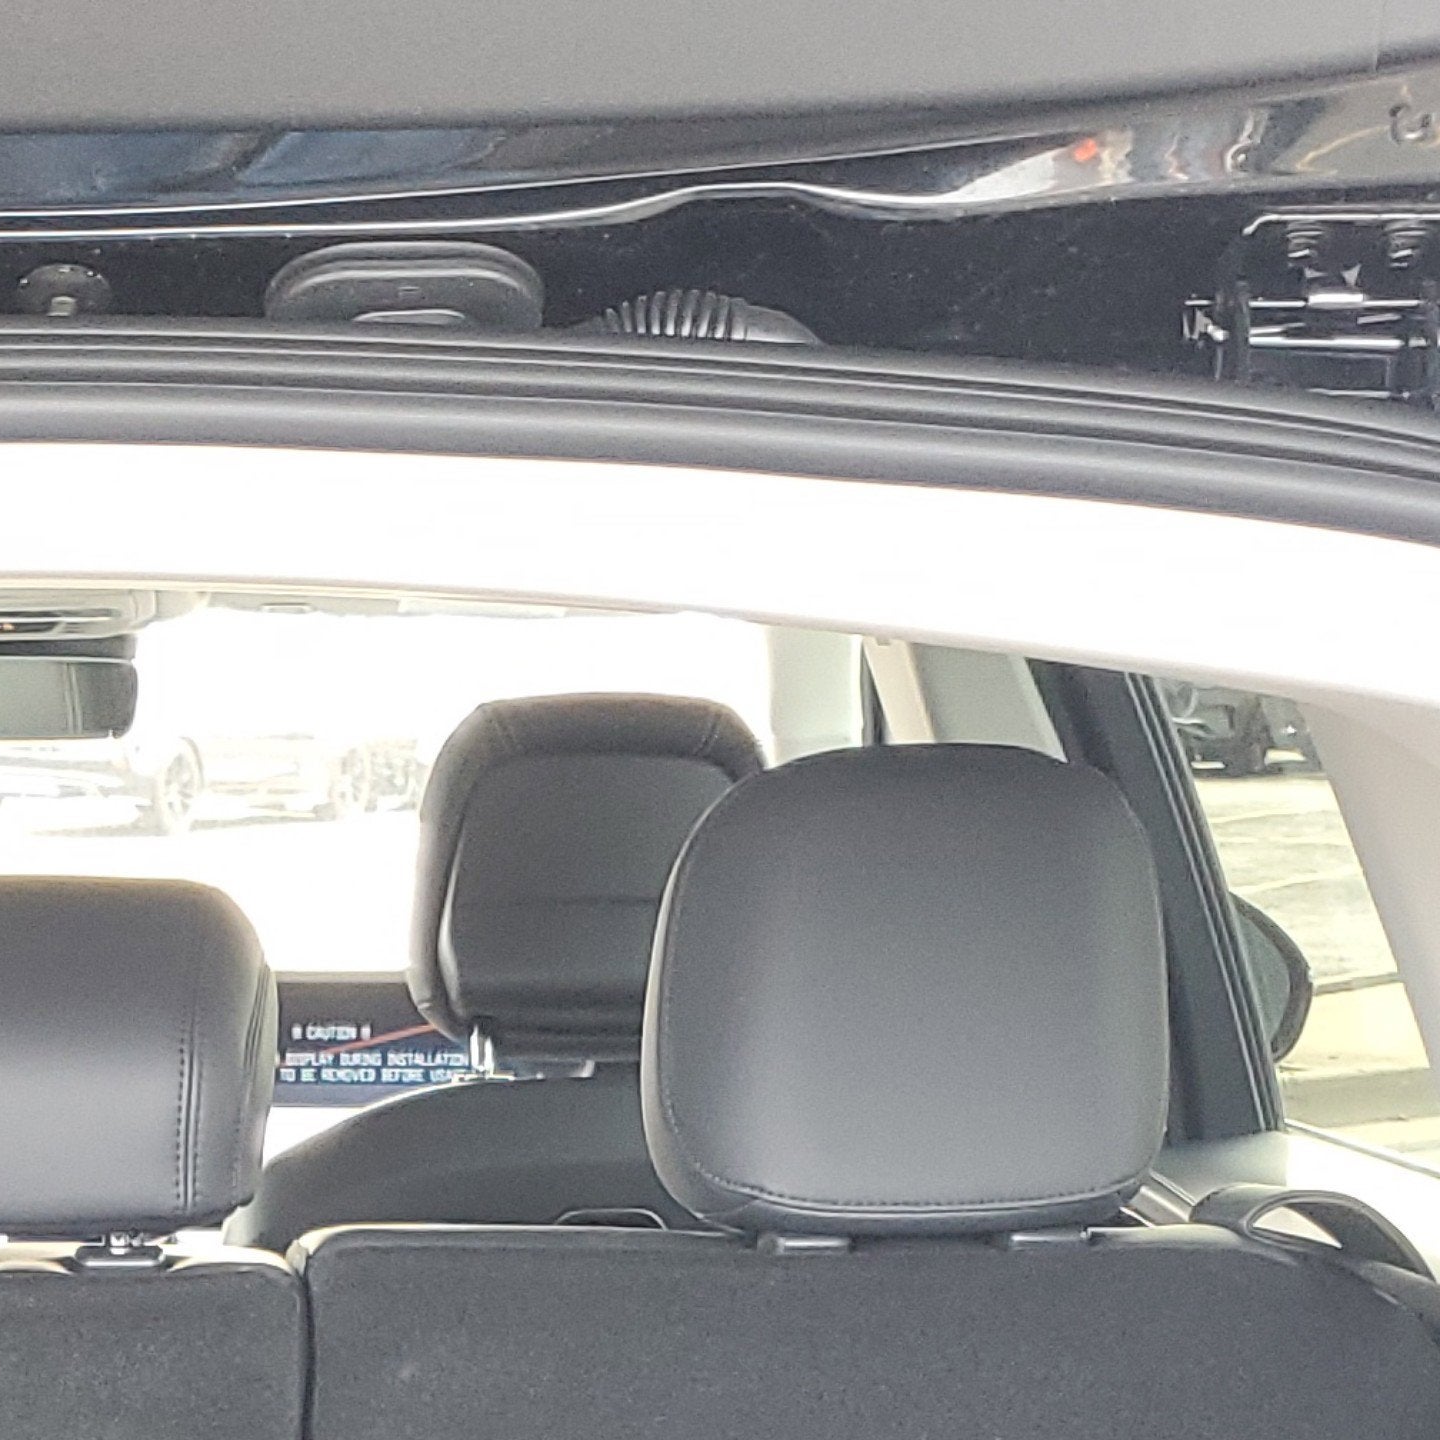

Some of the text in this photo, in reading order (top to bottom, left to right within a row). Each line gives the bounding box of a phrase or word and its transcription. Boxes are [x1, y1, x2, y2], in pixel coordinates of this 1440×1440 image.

[305, 1025, 358, 1041] CAUTION
[285, 1052, 469, 1067] DISPLAY DURING INSTALLATION
[279, 1068, 296, 1082] TO
[300, 1068, 317, 1082] BE
[321, 1068, 376, 1083] REMOVED
[380, 1068, 425, 1082] BEFORE
